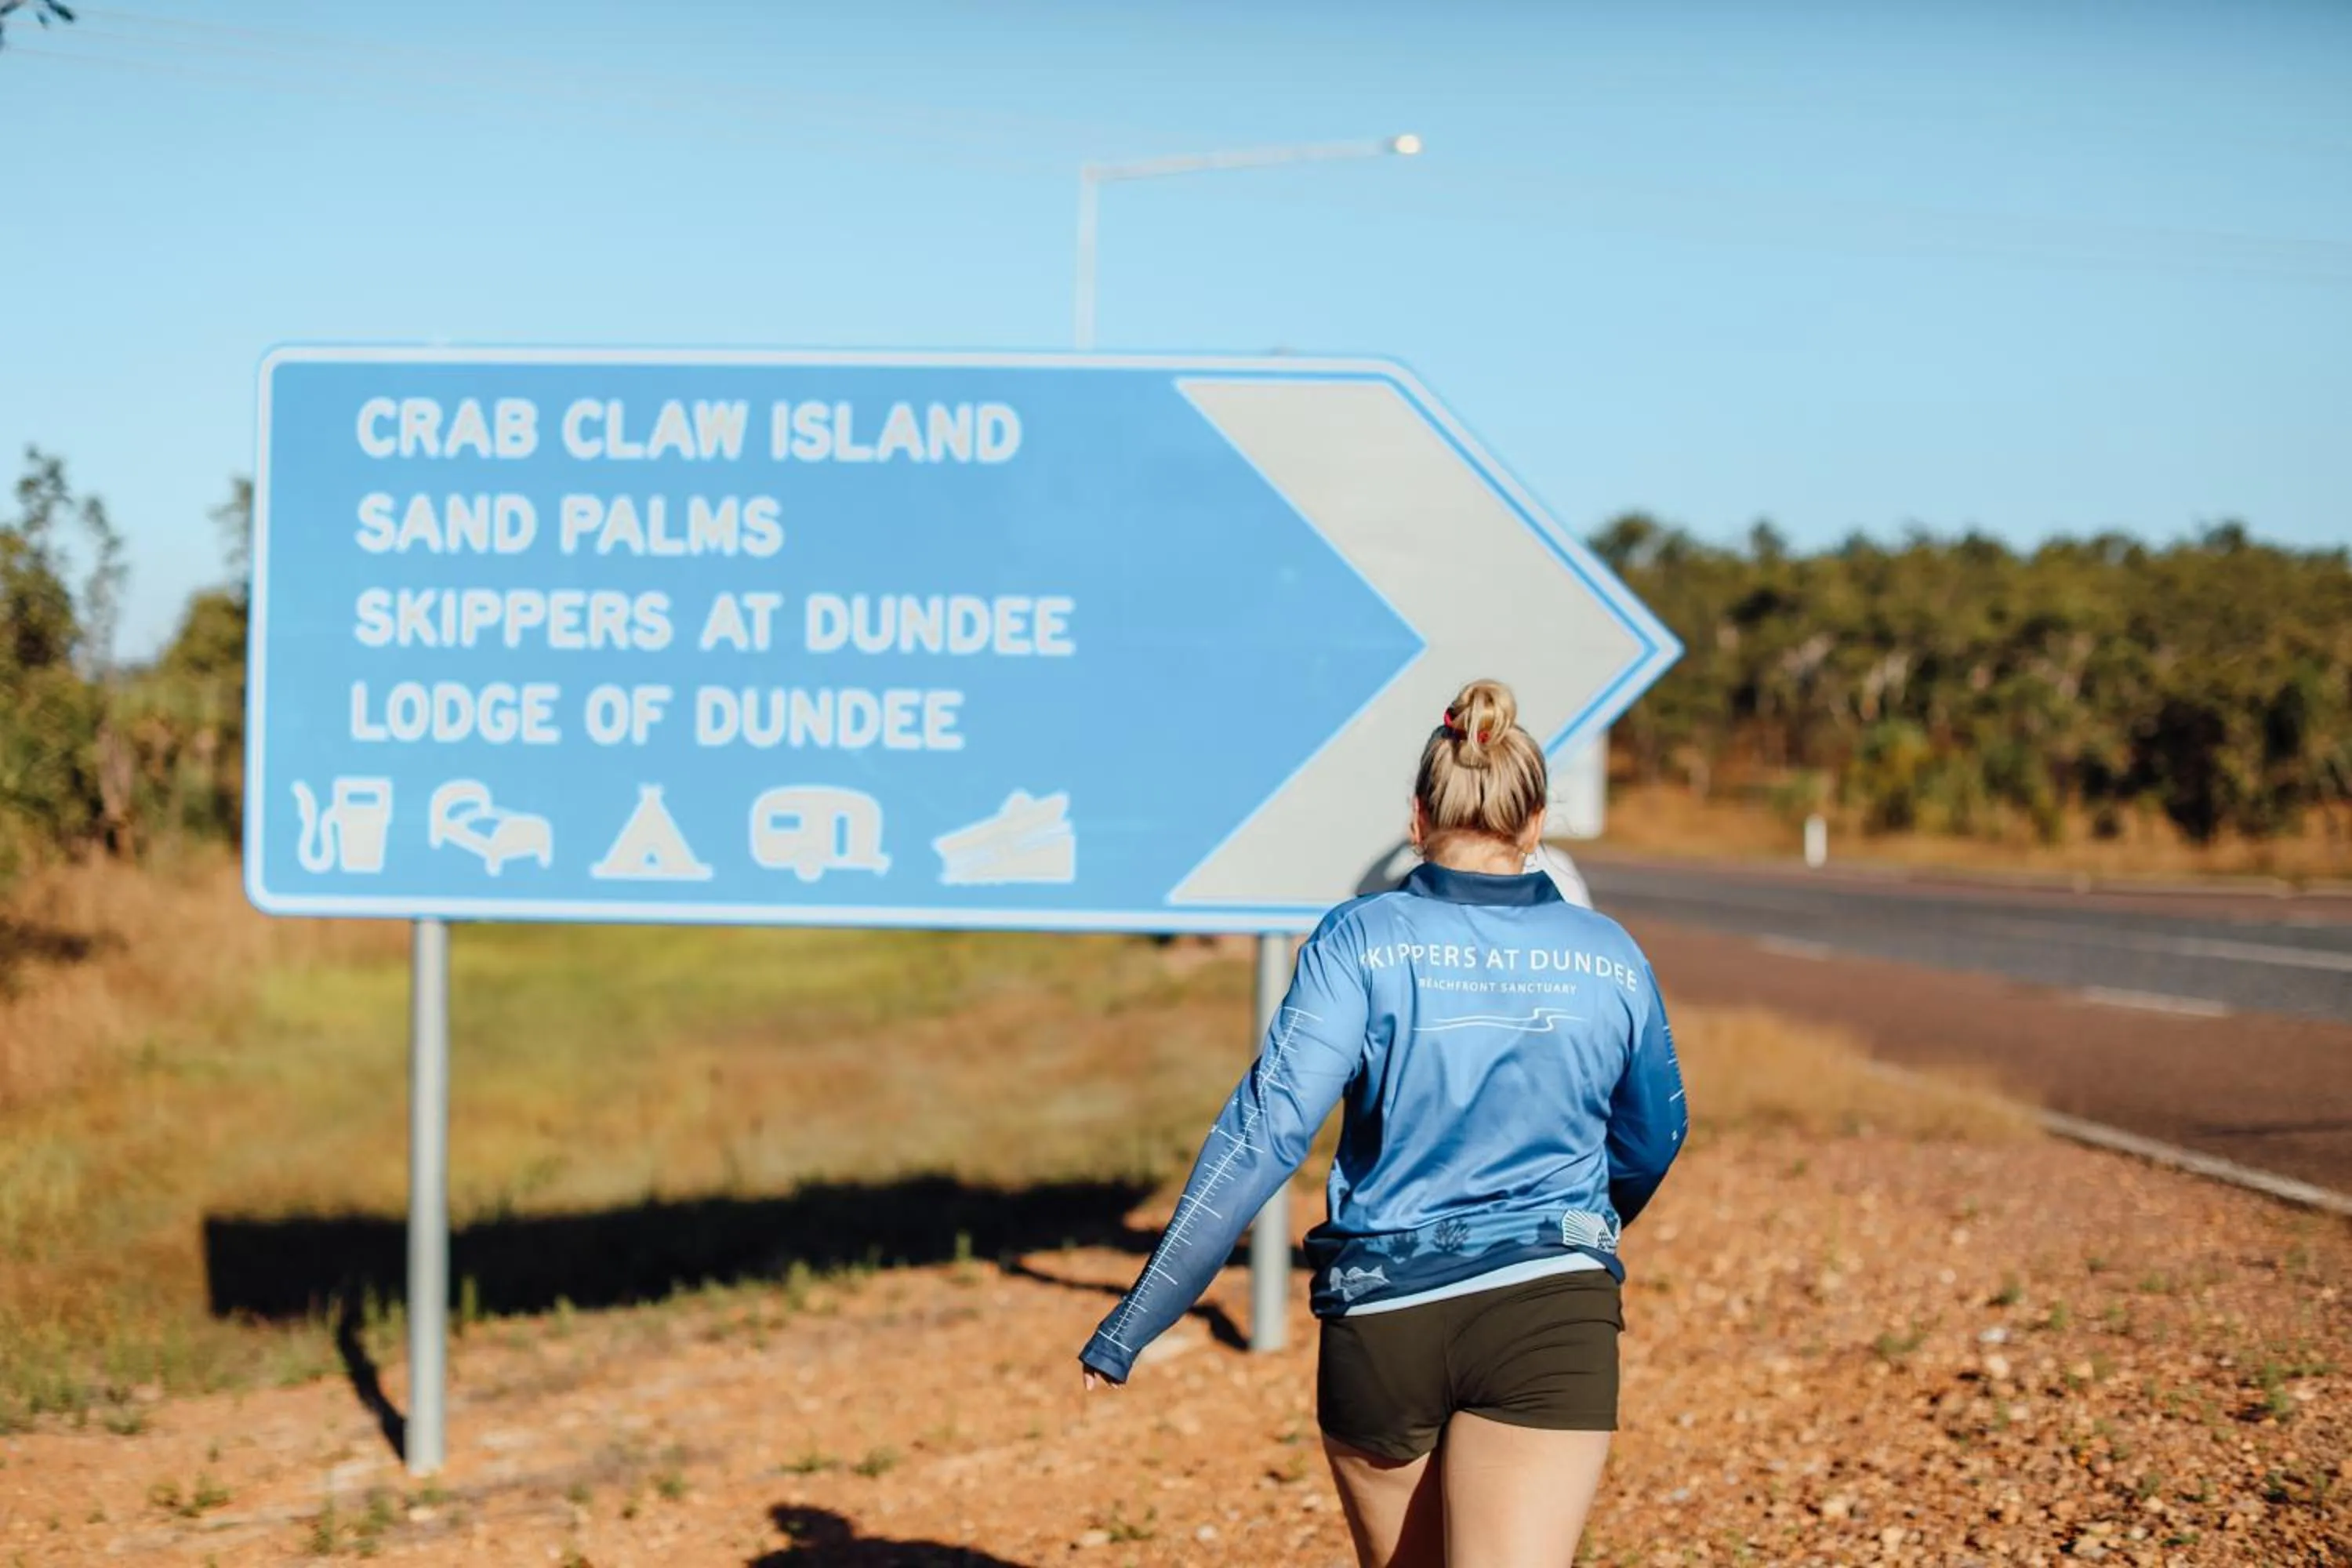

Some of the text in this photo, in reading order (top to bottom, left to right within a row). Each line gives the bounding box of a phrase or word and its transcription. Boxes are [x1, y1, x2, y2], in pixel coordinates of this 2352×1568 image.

[356, 397, 1022, 463] CRAB CLAW ISLAND
[355, 492, 784, 557] SAND PALMS
[354, 588, 1075, 656] SKIPPERS AT DUNDEE
[350, 681, 964, 750] LODGE OF DUNDEE
[1417, 977, 1577, 996] BEACHFRONT SANCTUARY
[1486, 949, 1519, 971] AT
[1530, 949, 1637, 993] DUNDEE
